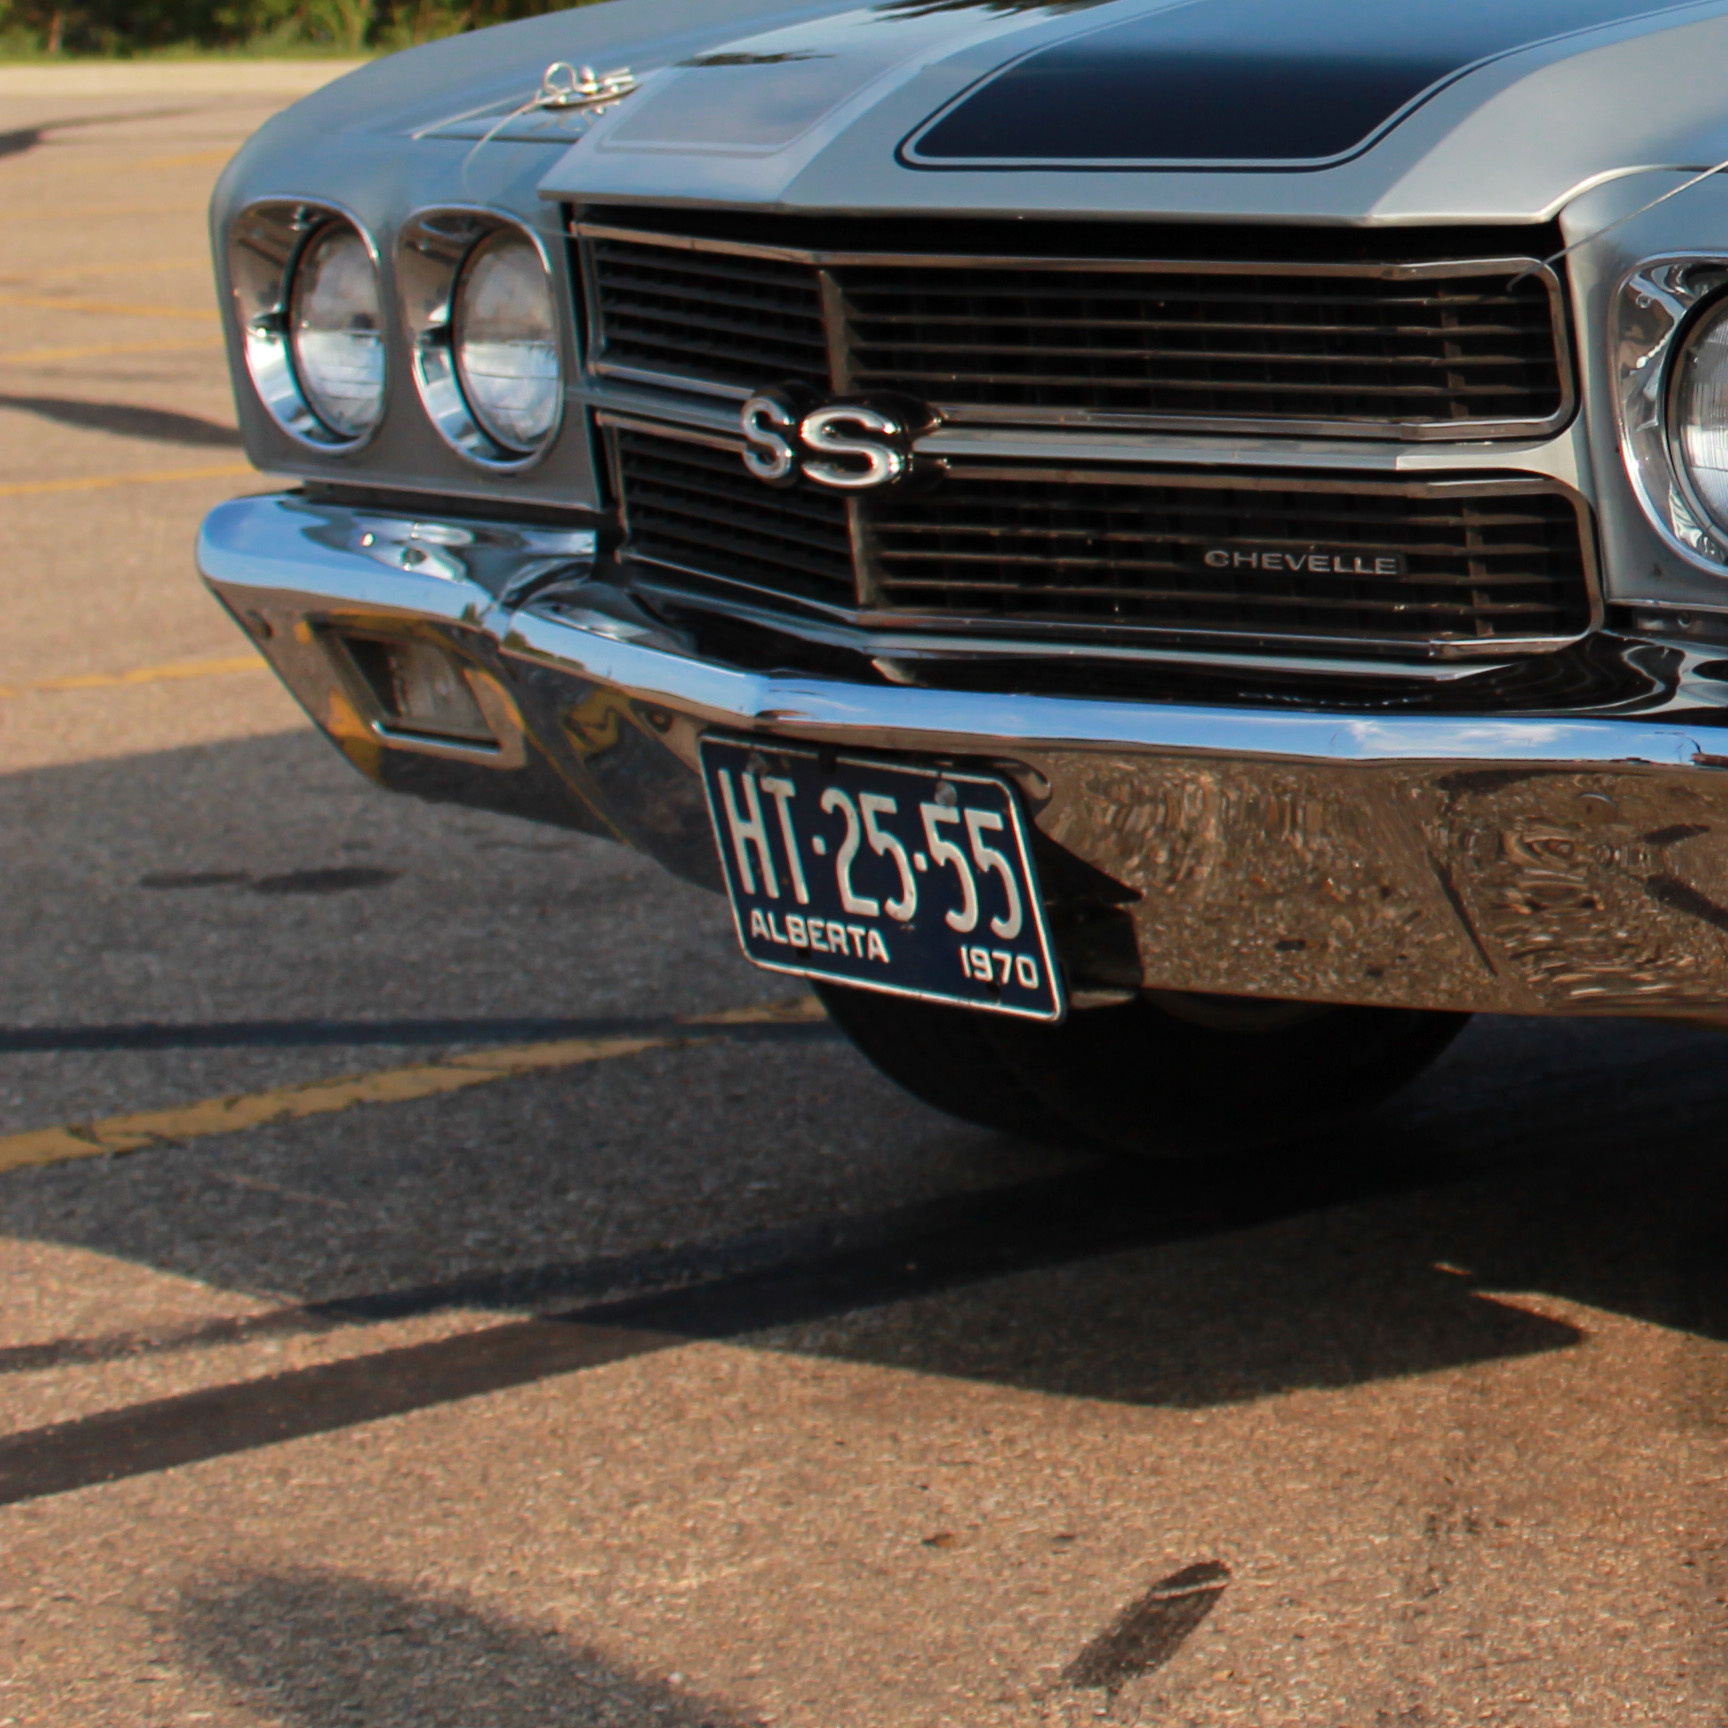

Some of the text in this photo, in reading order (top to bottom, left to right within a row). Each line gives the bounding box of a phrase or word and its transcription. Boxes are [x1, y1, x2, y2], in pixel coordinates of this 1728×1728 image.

[741, 397, 902, 489] SS
[1203, 549, 1398, 575] CHEVELLE
[750, 908, 890, 964] ALBERTA
[959, 945, 1040, 990] 1970
